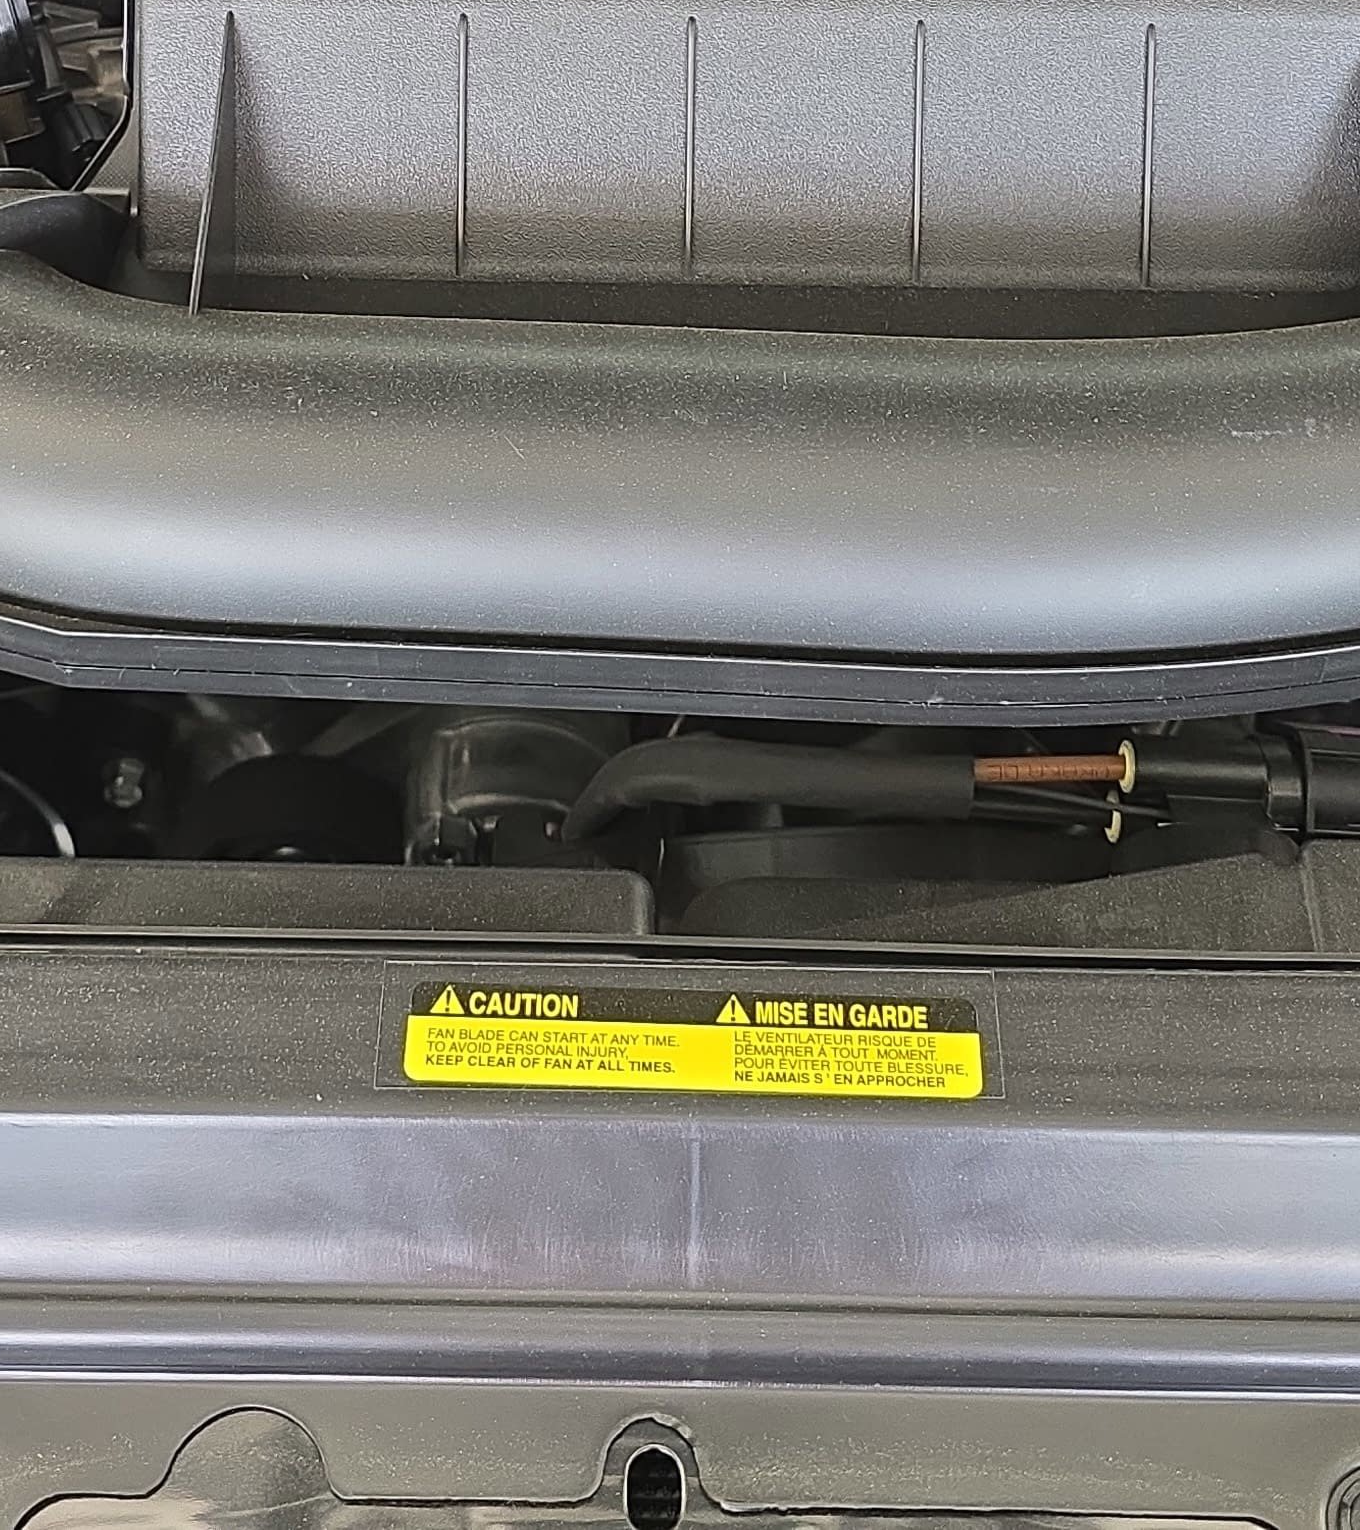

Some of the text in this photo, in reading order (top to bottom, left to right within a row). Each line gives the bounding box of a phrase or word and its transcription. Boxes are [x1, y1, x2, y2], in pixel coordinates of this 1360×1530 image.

[468, 991, 579, 1018] CAUTION
[754, 1000, 929, 1030] MISE EN GARDE
[427, 1027, 680, 1047] FAN BLADE CAN START AT ANY TIME.
[734, 1031, 937, 1048] LE VENTILATEUR RISQUE DE
[427, 1040, 629, 1060] TO AVOID PERSONAL INJURY,
[734, 1042, 939, 1062] DÉMARRER À TOUT MOMENT.
[425, 1053, 676, 1074] KEEP CLEAR OF FAN AT ALL TIMES.
[734, 1055, 969, 1078] POUR ÉVITER TOUTE BLESSURE,
[734, 1070, 754, 1082] NE
[756, 1071, 810, 1084] JAMAIS
[833, 1074, 854, 1086] EN
[856, 1075, 946, 1089] APPROCHER
